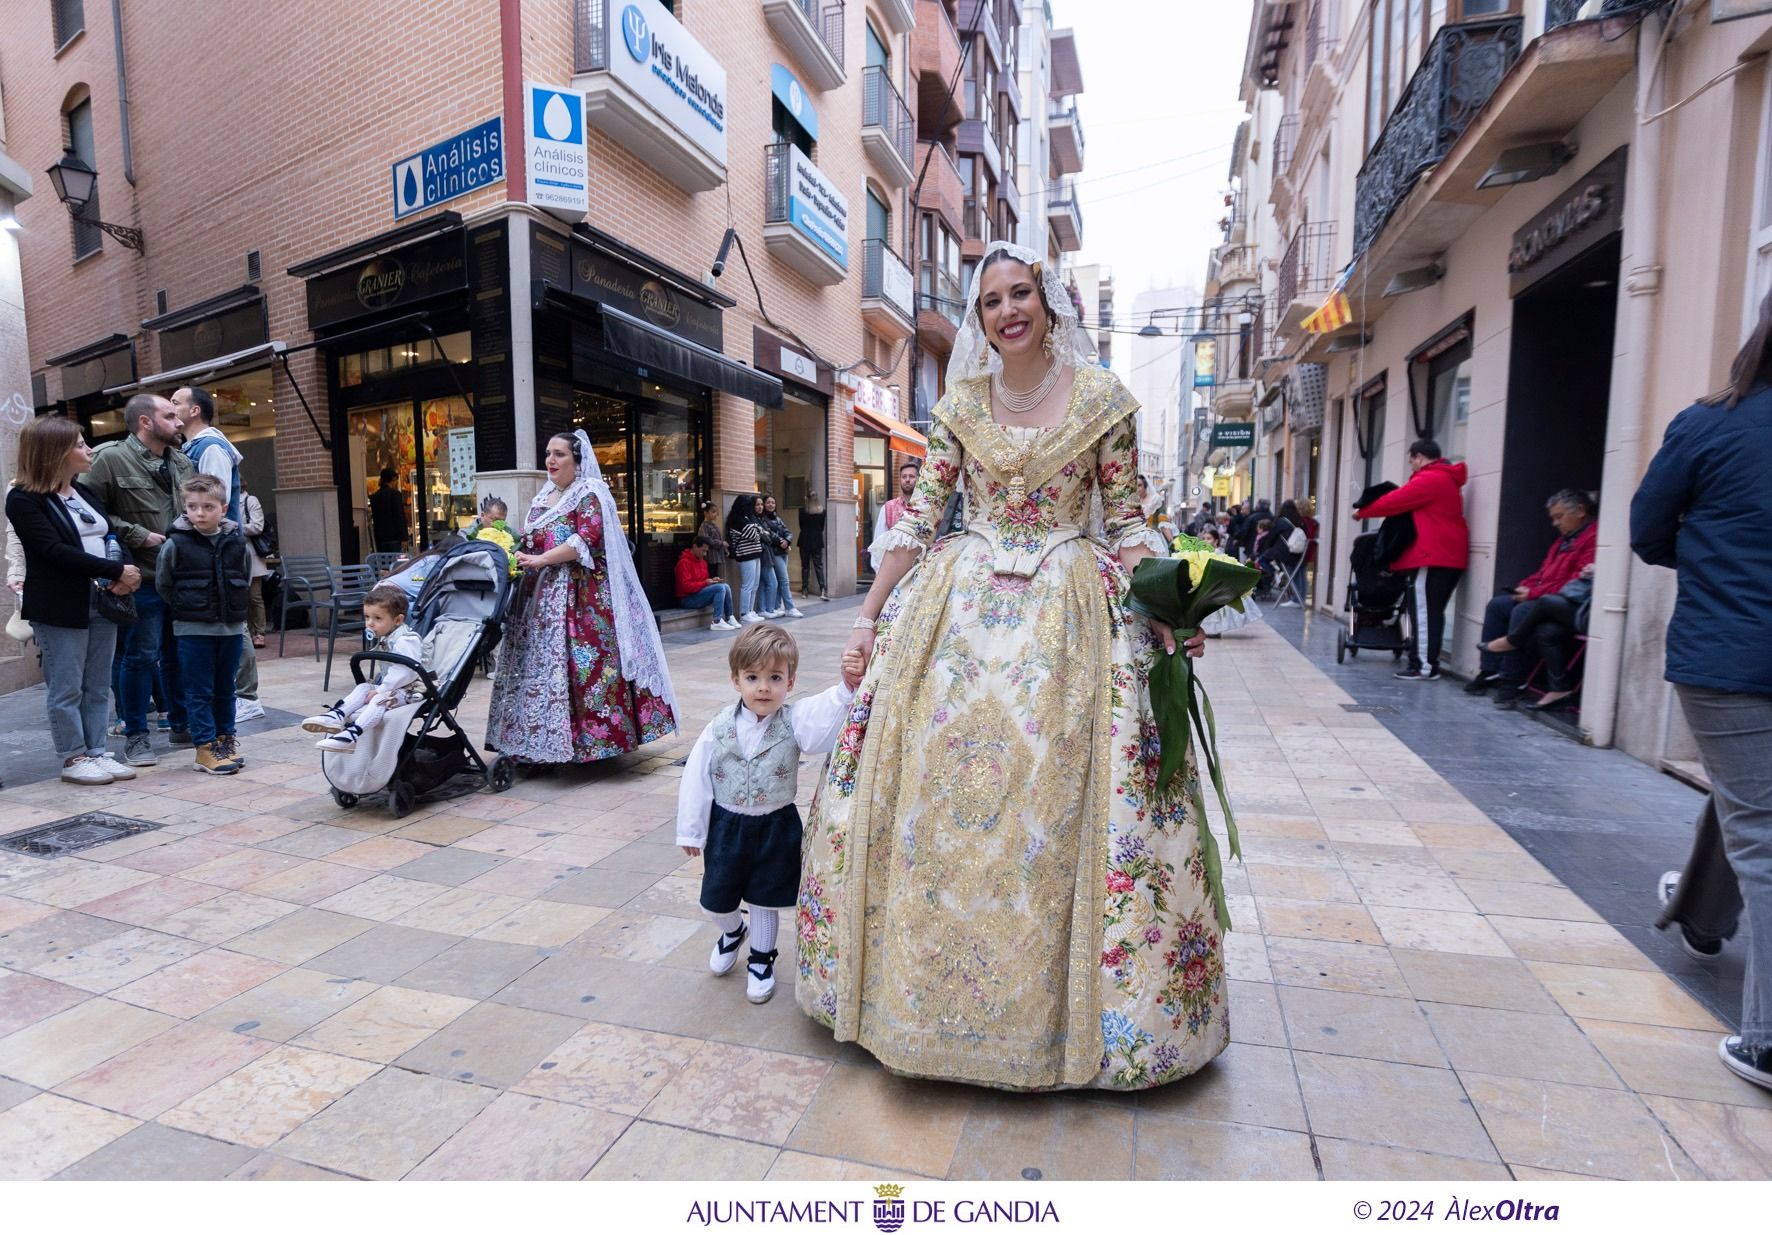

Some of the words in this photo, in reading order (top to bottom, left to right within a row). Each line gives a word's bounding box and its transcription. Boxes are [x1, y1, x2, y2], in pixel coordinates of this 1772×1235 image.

[651, 32, 673, 71] Iris
[426, 129, 499, 178] Análisis
[533, 145, 584, 164] Análisis
[427, 157, 500, 201] clínicos
[534, 160, 584, 178] clínicos
[359, 269, 402, 296] GRANIER
[640, 290, 679, 317] GRANIER
